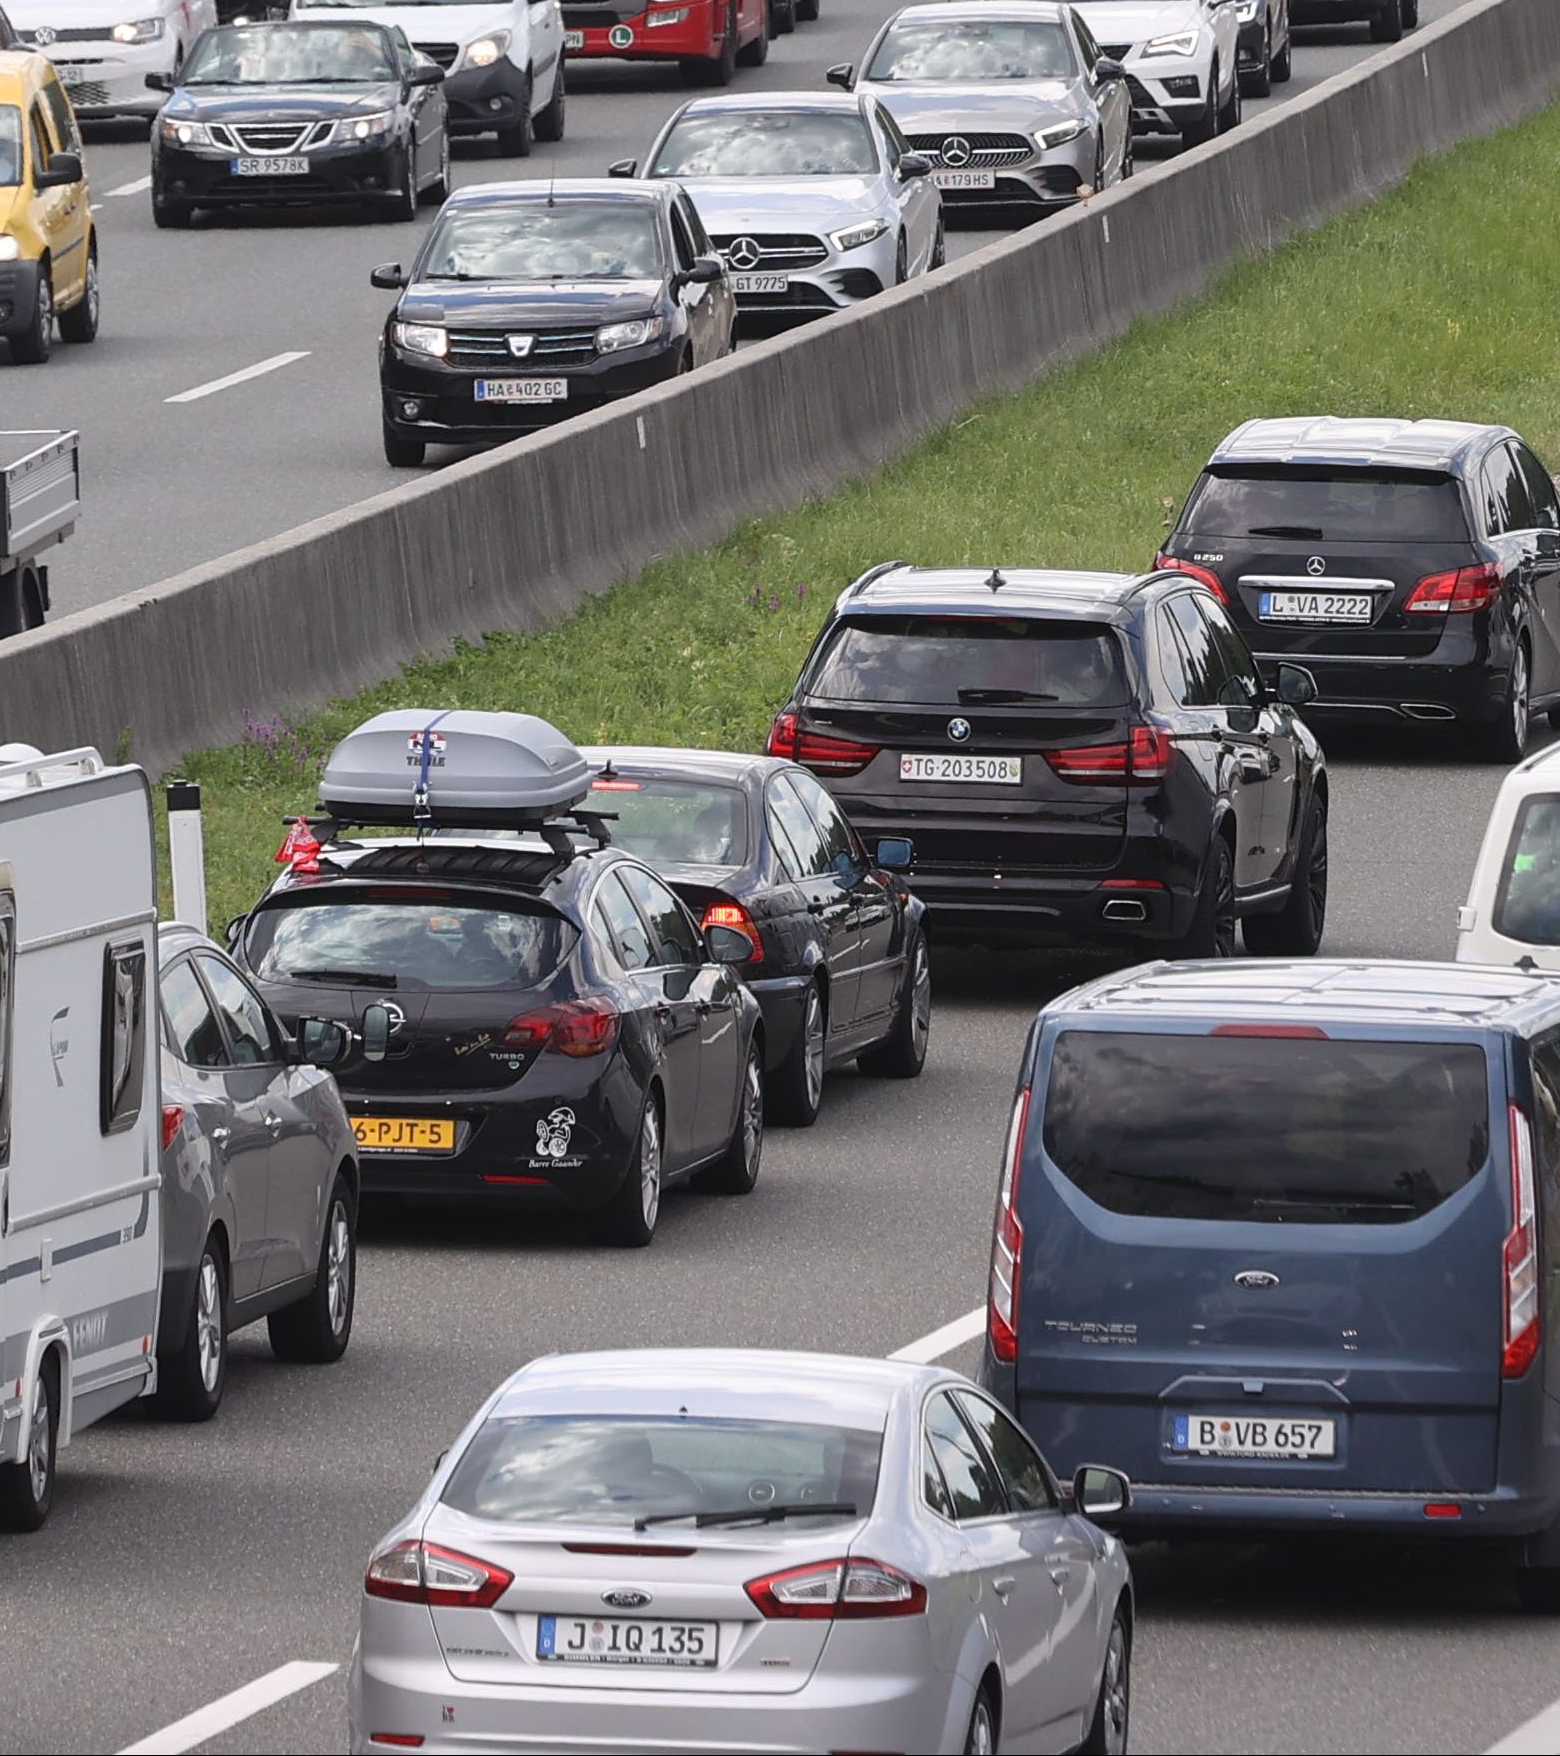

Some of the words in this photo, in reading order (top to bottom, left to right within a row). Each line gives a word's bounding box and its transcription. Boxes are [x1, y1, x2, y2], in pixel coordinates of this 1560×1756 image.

[615, 29, 627, 45] L
[239, 160, 260, 173] SR
[736, 277, 752, 290] GT
[755, 276, 786, 290] 9775
[487, 385, 505, 397] HA
[1272, 595, 1284, 613] L
[1297, 596, 1319, 614] VA
[1323, 597, 1369, 616] 2222
[489, 1052, 525, 1061] TURBO
[355, 1121, 442, 1144] 6-PJT-5
[1045, 1320, 1138, 1334] TOURNEO
[1199, 1421, 1216, 1446] B
[1235, 1422, 1268, 1448] VB
[1273, 1424, 1323, 1450] 657
[567, 1623, 586, 1650] J
[607, 1624, 643, 1652] IQ
[650, 1626, 705, 1654] 135
